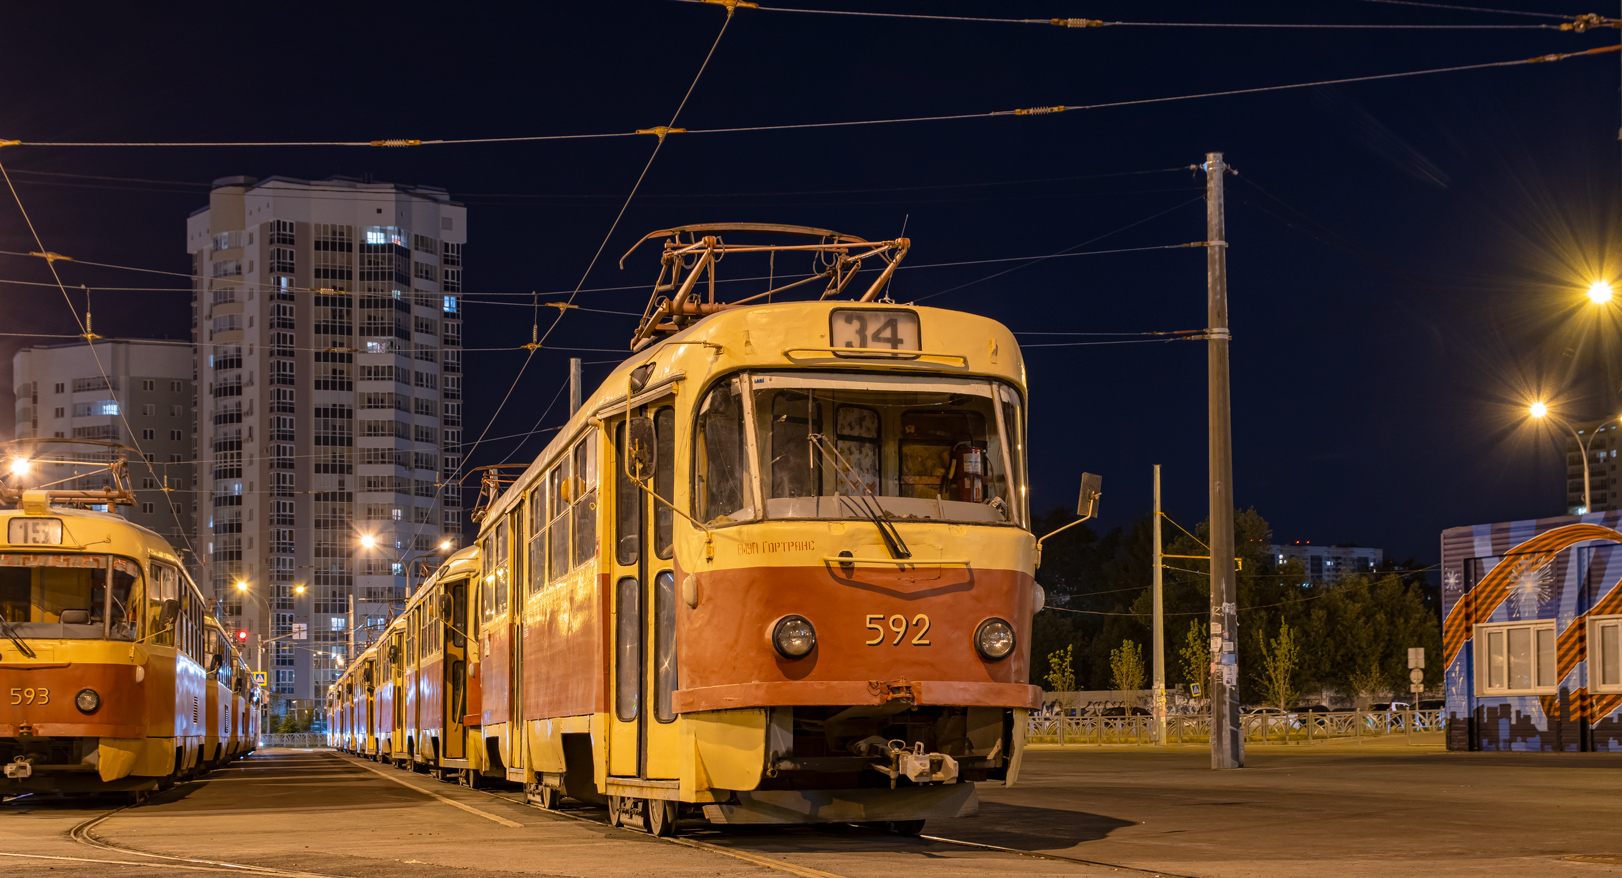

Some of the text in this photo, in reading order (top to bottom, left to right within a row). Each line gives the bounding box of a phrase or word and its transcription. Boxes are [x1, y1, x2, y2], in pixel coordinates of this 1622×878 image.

[844, 314, 904, 357] 34
[762, 540, 815, 554] ГОРТРАНС
[865, 613, 932, 646] 592
[10, 687, 50, 706] 593
